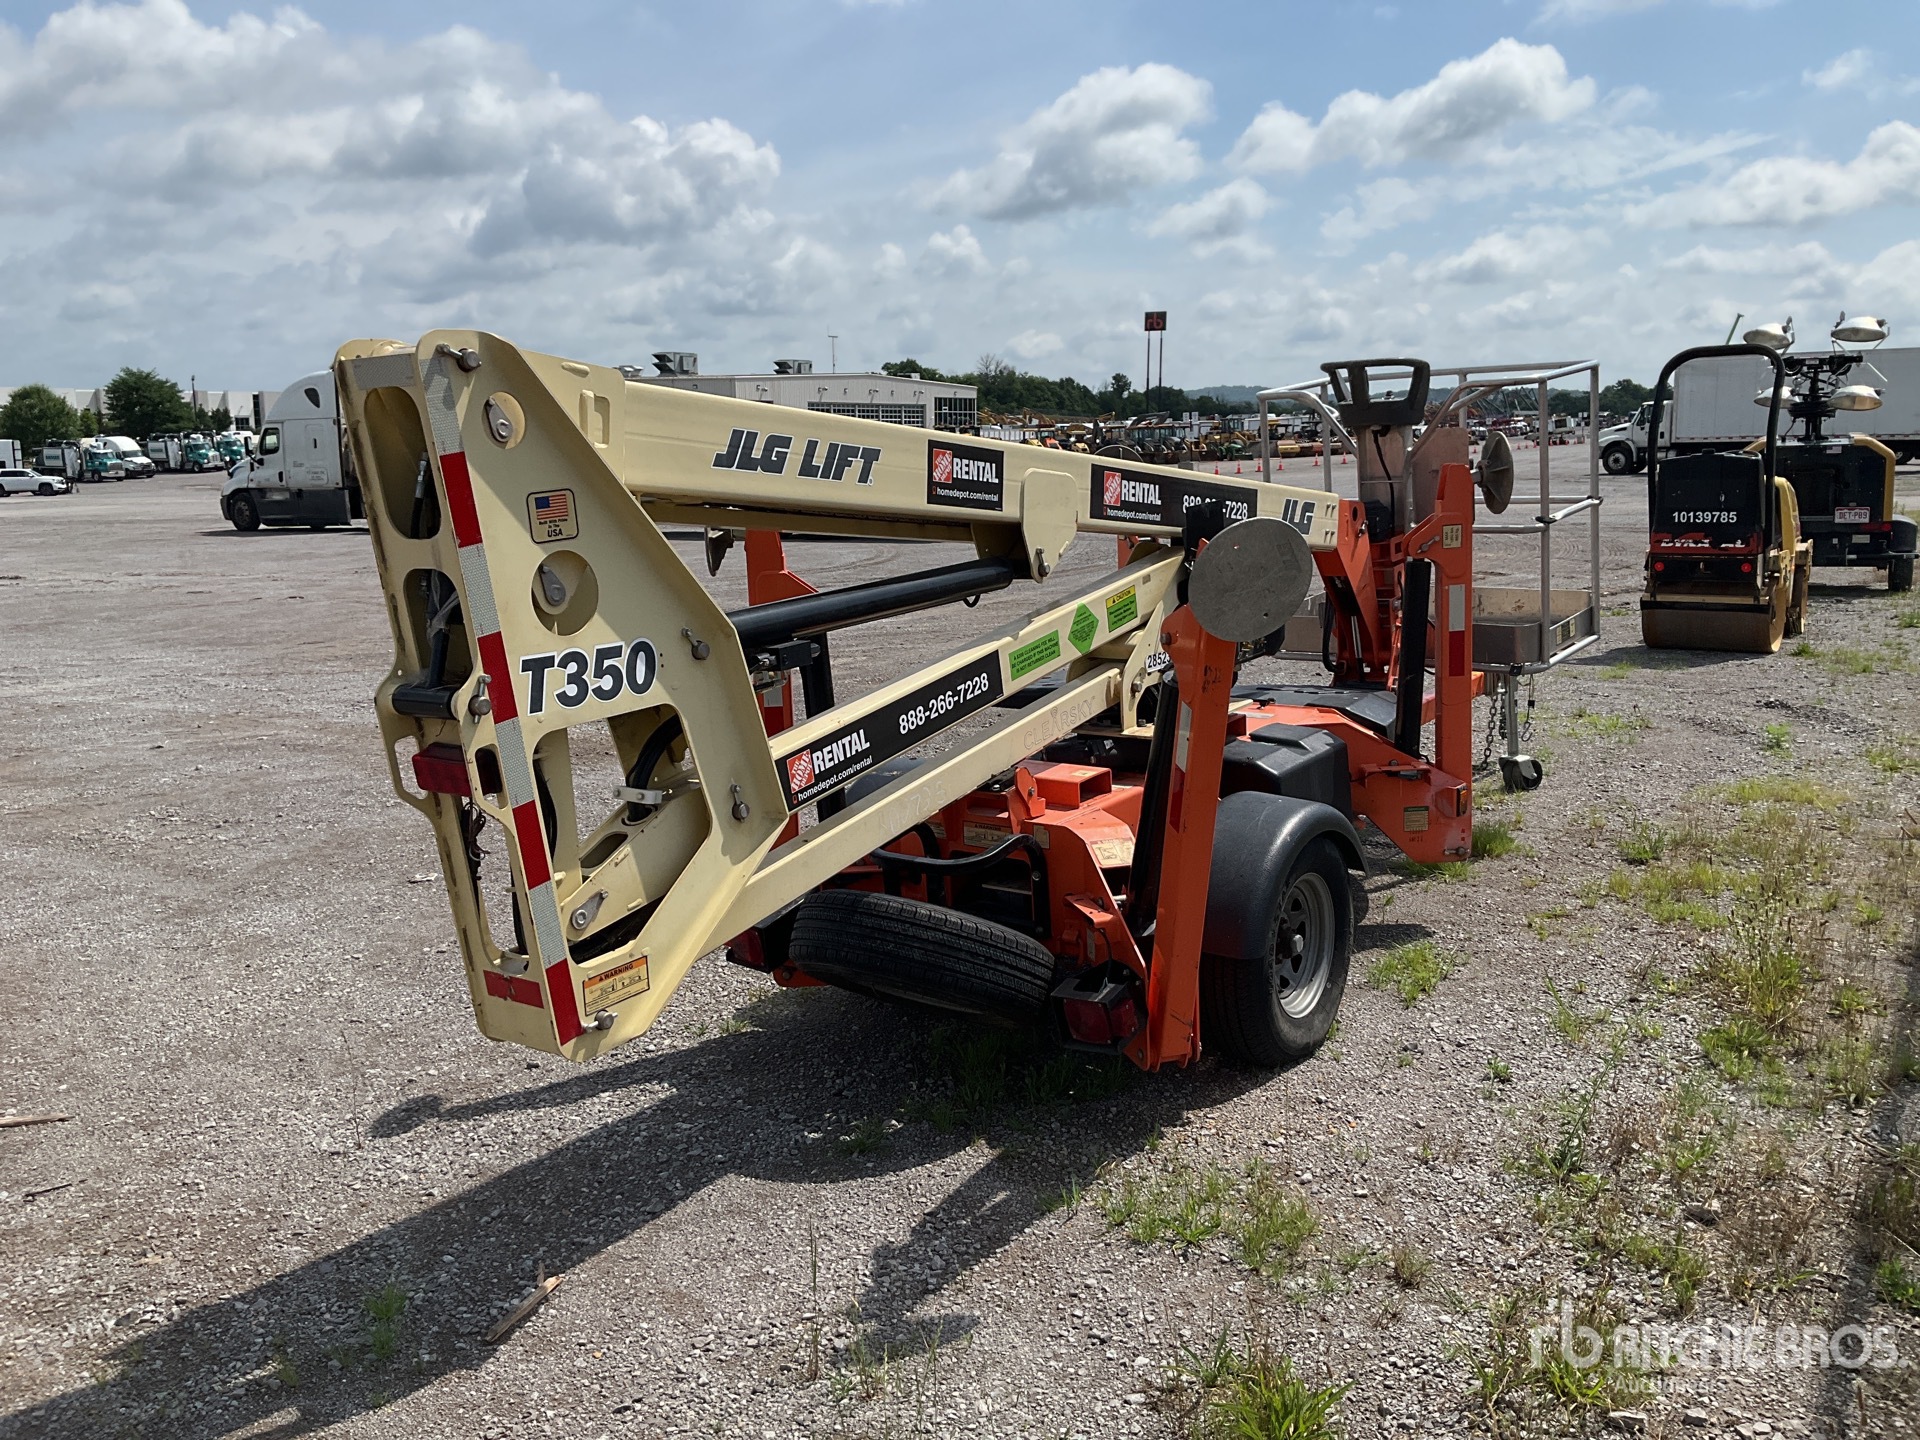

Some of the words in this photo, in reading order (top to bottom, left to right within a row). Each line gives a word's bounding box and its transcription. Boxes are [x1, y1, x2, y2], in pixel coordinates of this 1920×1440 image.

[711, 427, 794, 475] JLG
[797, 438, 882, 485] LIFT
[953, 458, 999, 483] RENTAL
[936, 486, 999, 502] homedepot.com/rental
[1121, 480, 1162, 505] RENTAL
[1107, 507, 1161, 521] homedepot.com/rental
[1672, 511, 1737, 523] 10139785
[547, 528, 563, 537] USA
[520, 637, 657, 716] T350
[812, 729, 870, 774] RENTAL
[899, 672, 989, 734] 888-266-7228
[797, 755, 873, 801] homedepot.com/rental
[604, 963, 633, 979] WARNING
